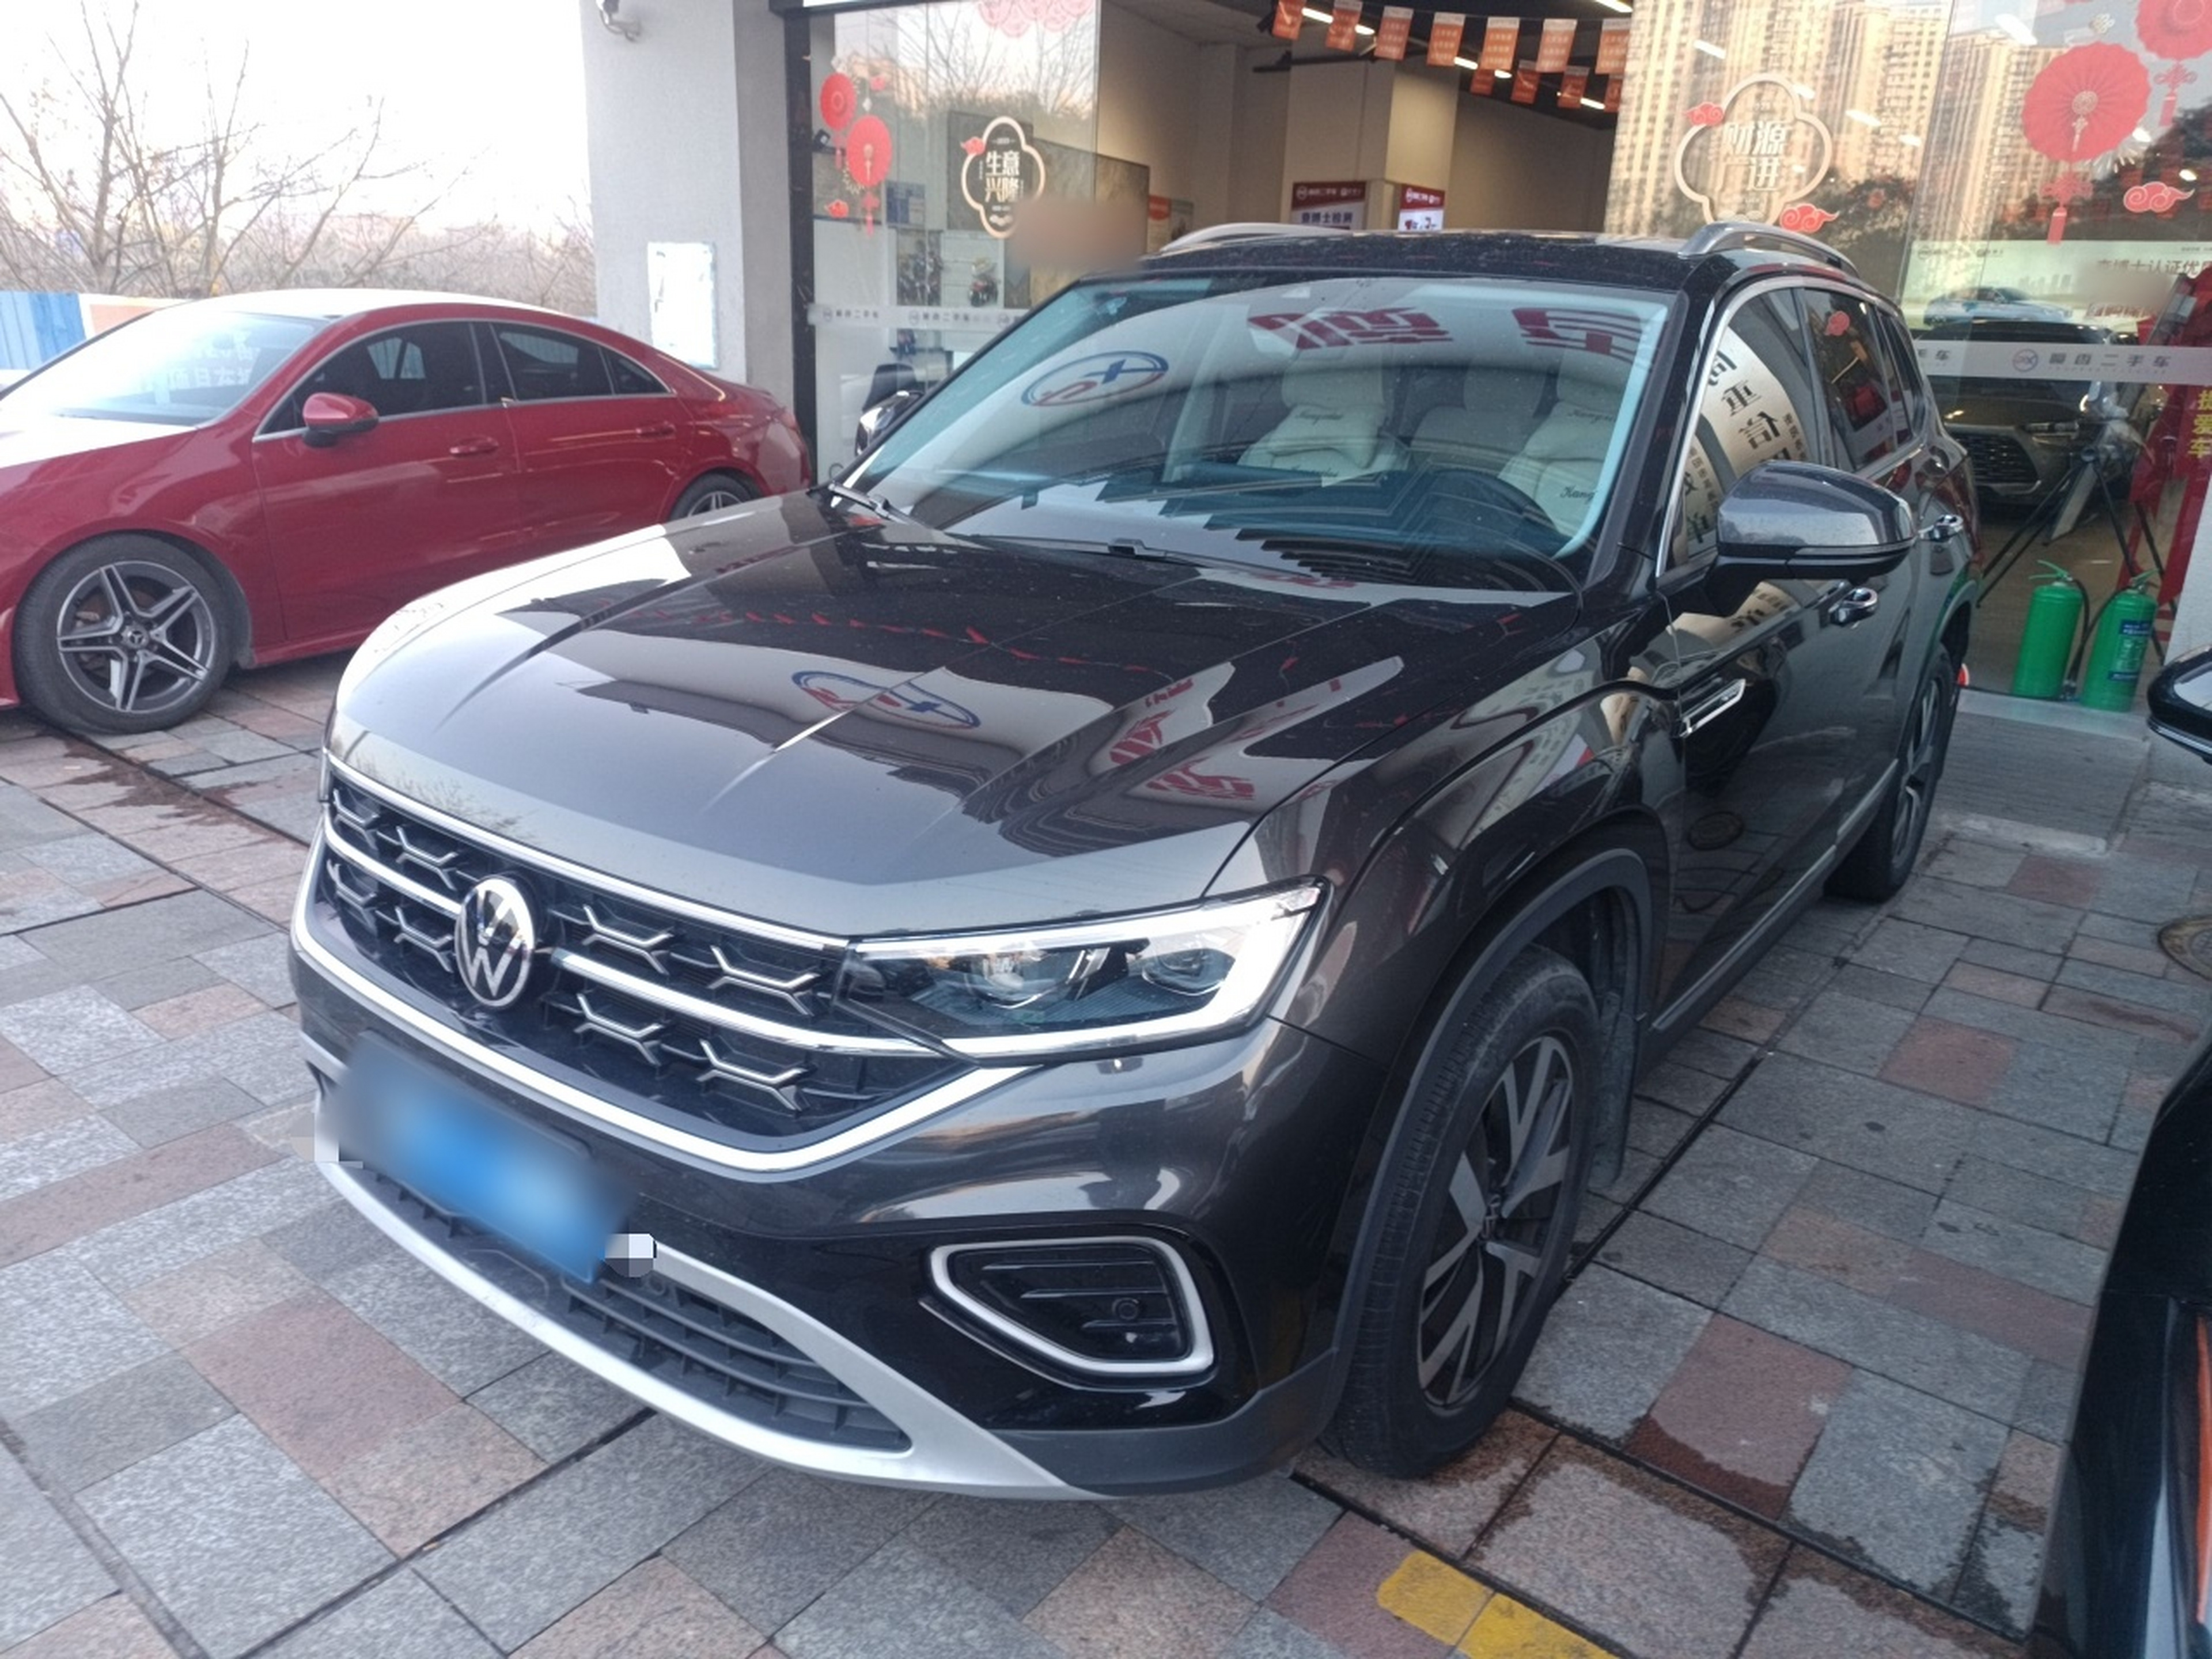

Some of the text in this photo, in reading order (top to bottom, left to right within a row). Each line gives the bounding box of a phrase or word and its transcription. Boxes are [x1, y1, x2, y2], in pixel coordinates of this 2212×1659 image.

[986, 150, 1020, 176] 生意
[984, 177, 1019, 202] 兴隆
[459, 878, 533, 1001] VW
